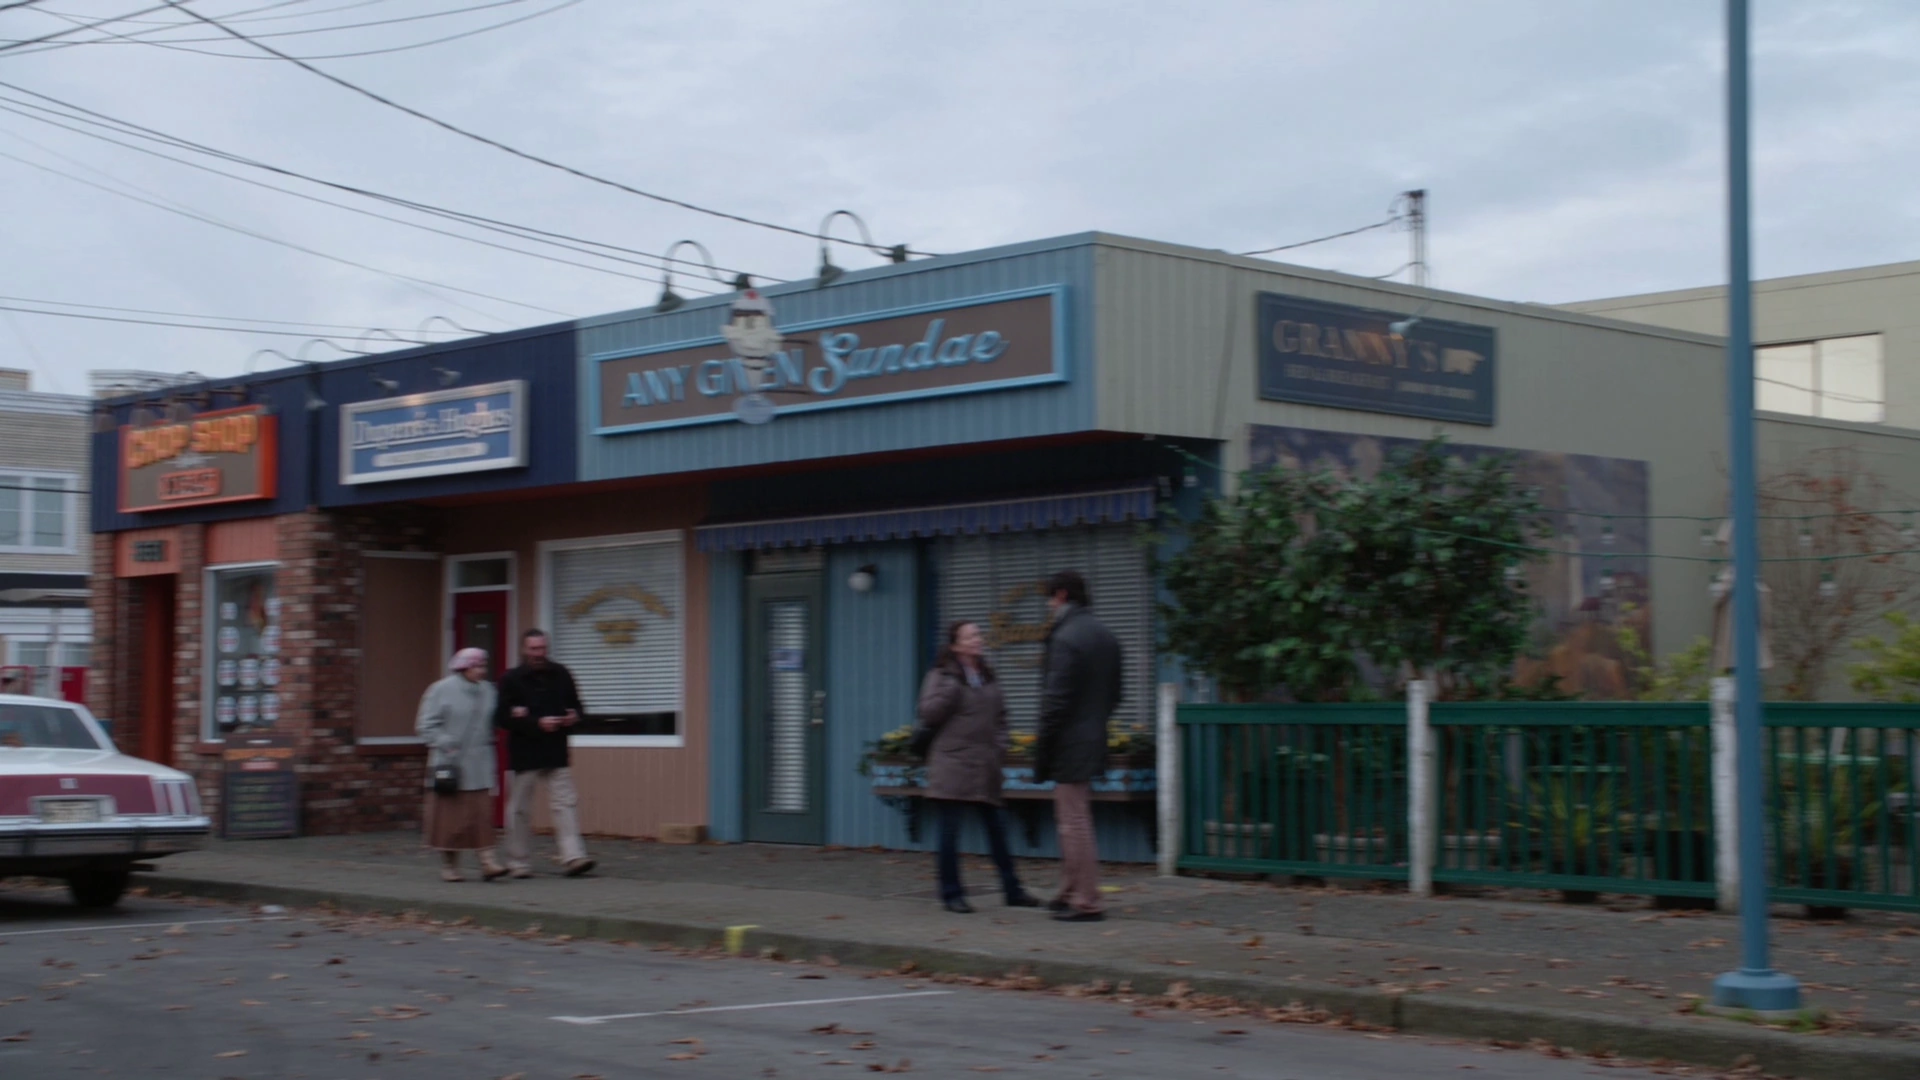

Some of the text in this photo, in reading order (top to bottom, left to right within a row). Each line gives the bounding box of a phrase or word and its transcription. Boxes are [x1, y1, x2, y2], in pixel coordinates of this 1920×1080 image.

[622, 365, 692, 408] ANY
[808, 318, 1010, 395] Sundae
[1273, 319, 1439, 373] GRANNY'S
[127, 414, 258, 469] CHOP SHOP
